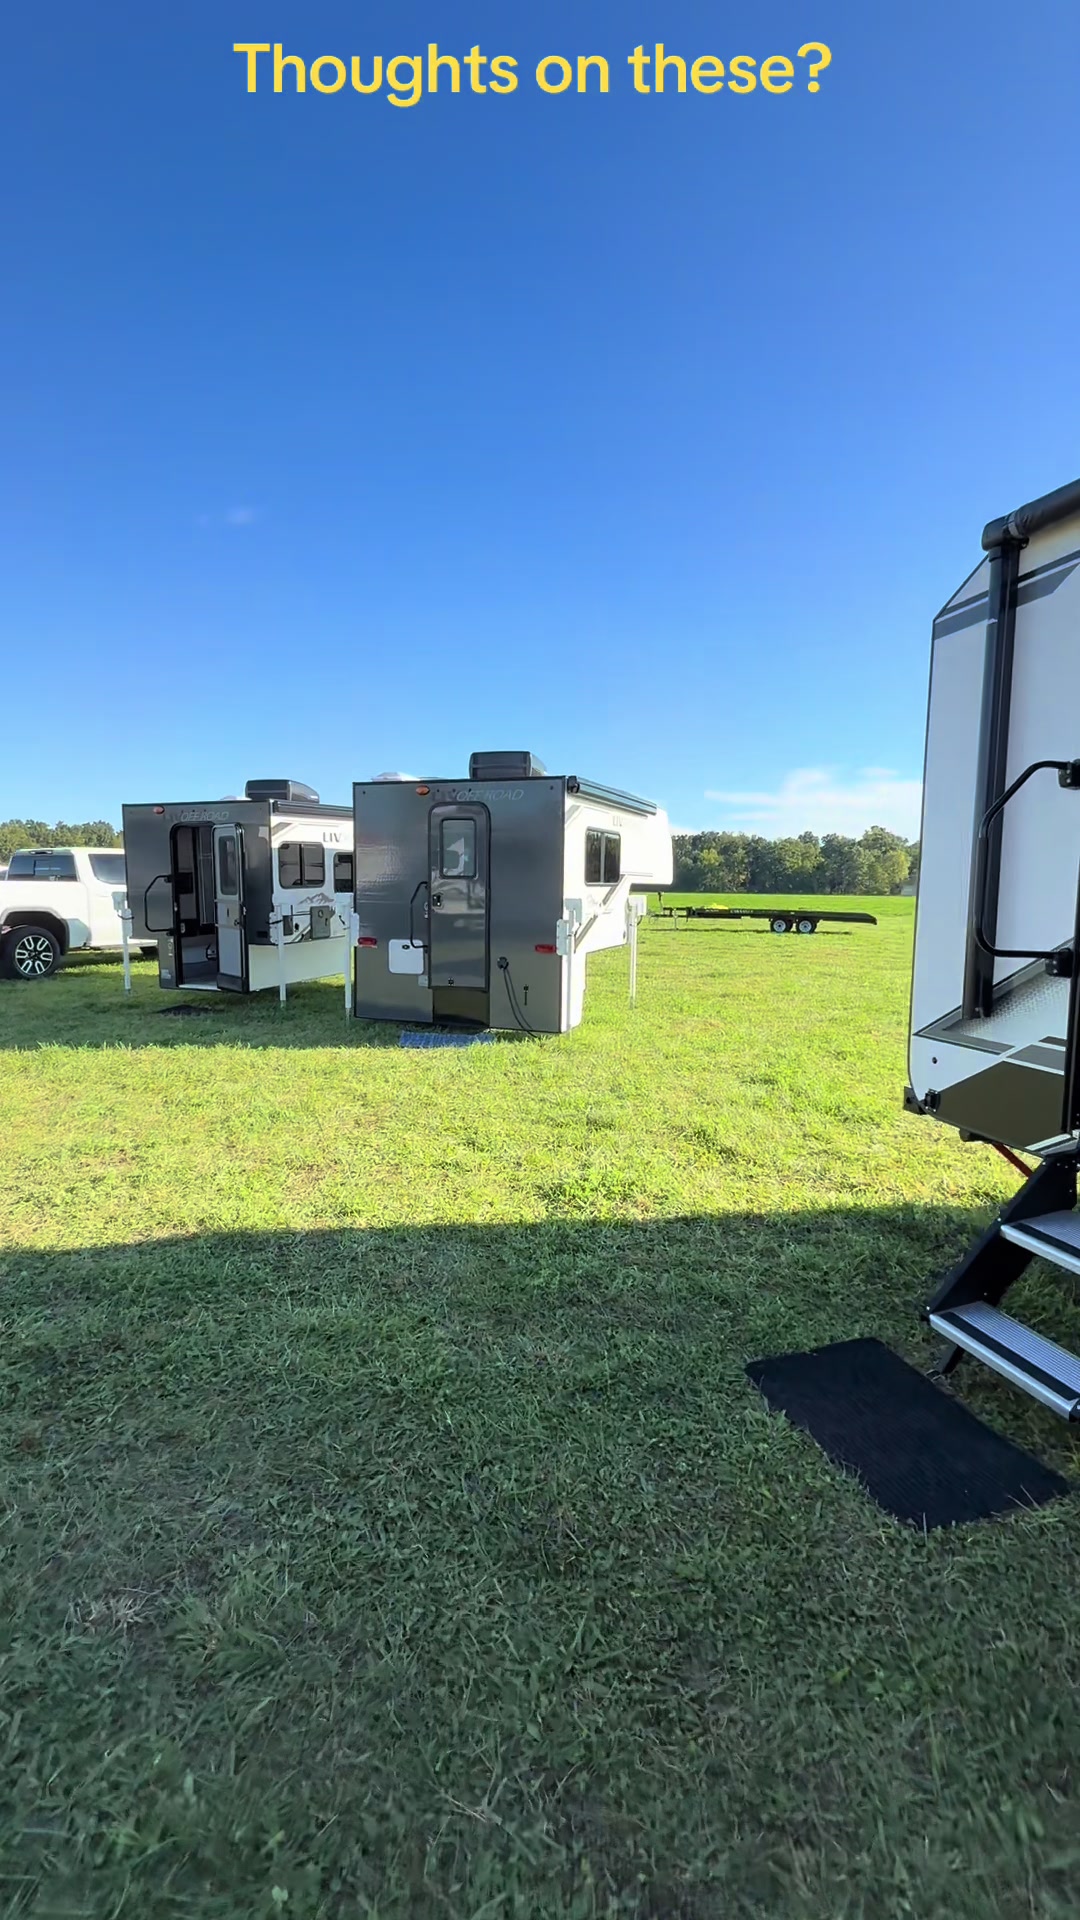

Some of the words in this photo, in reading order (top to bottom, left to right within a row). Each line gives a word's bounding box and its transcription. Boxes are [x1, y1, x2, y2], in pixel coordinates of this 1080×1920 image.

[456, 789, 484, 802] OFF
[485, 788, 525, 801] ROAD
[322, 831, 342, 844] LIV
